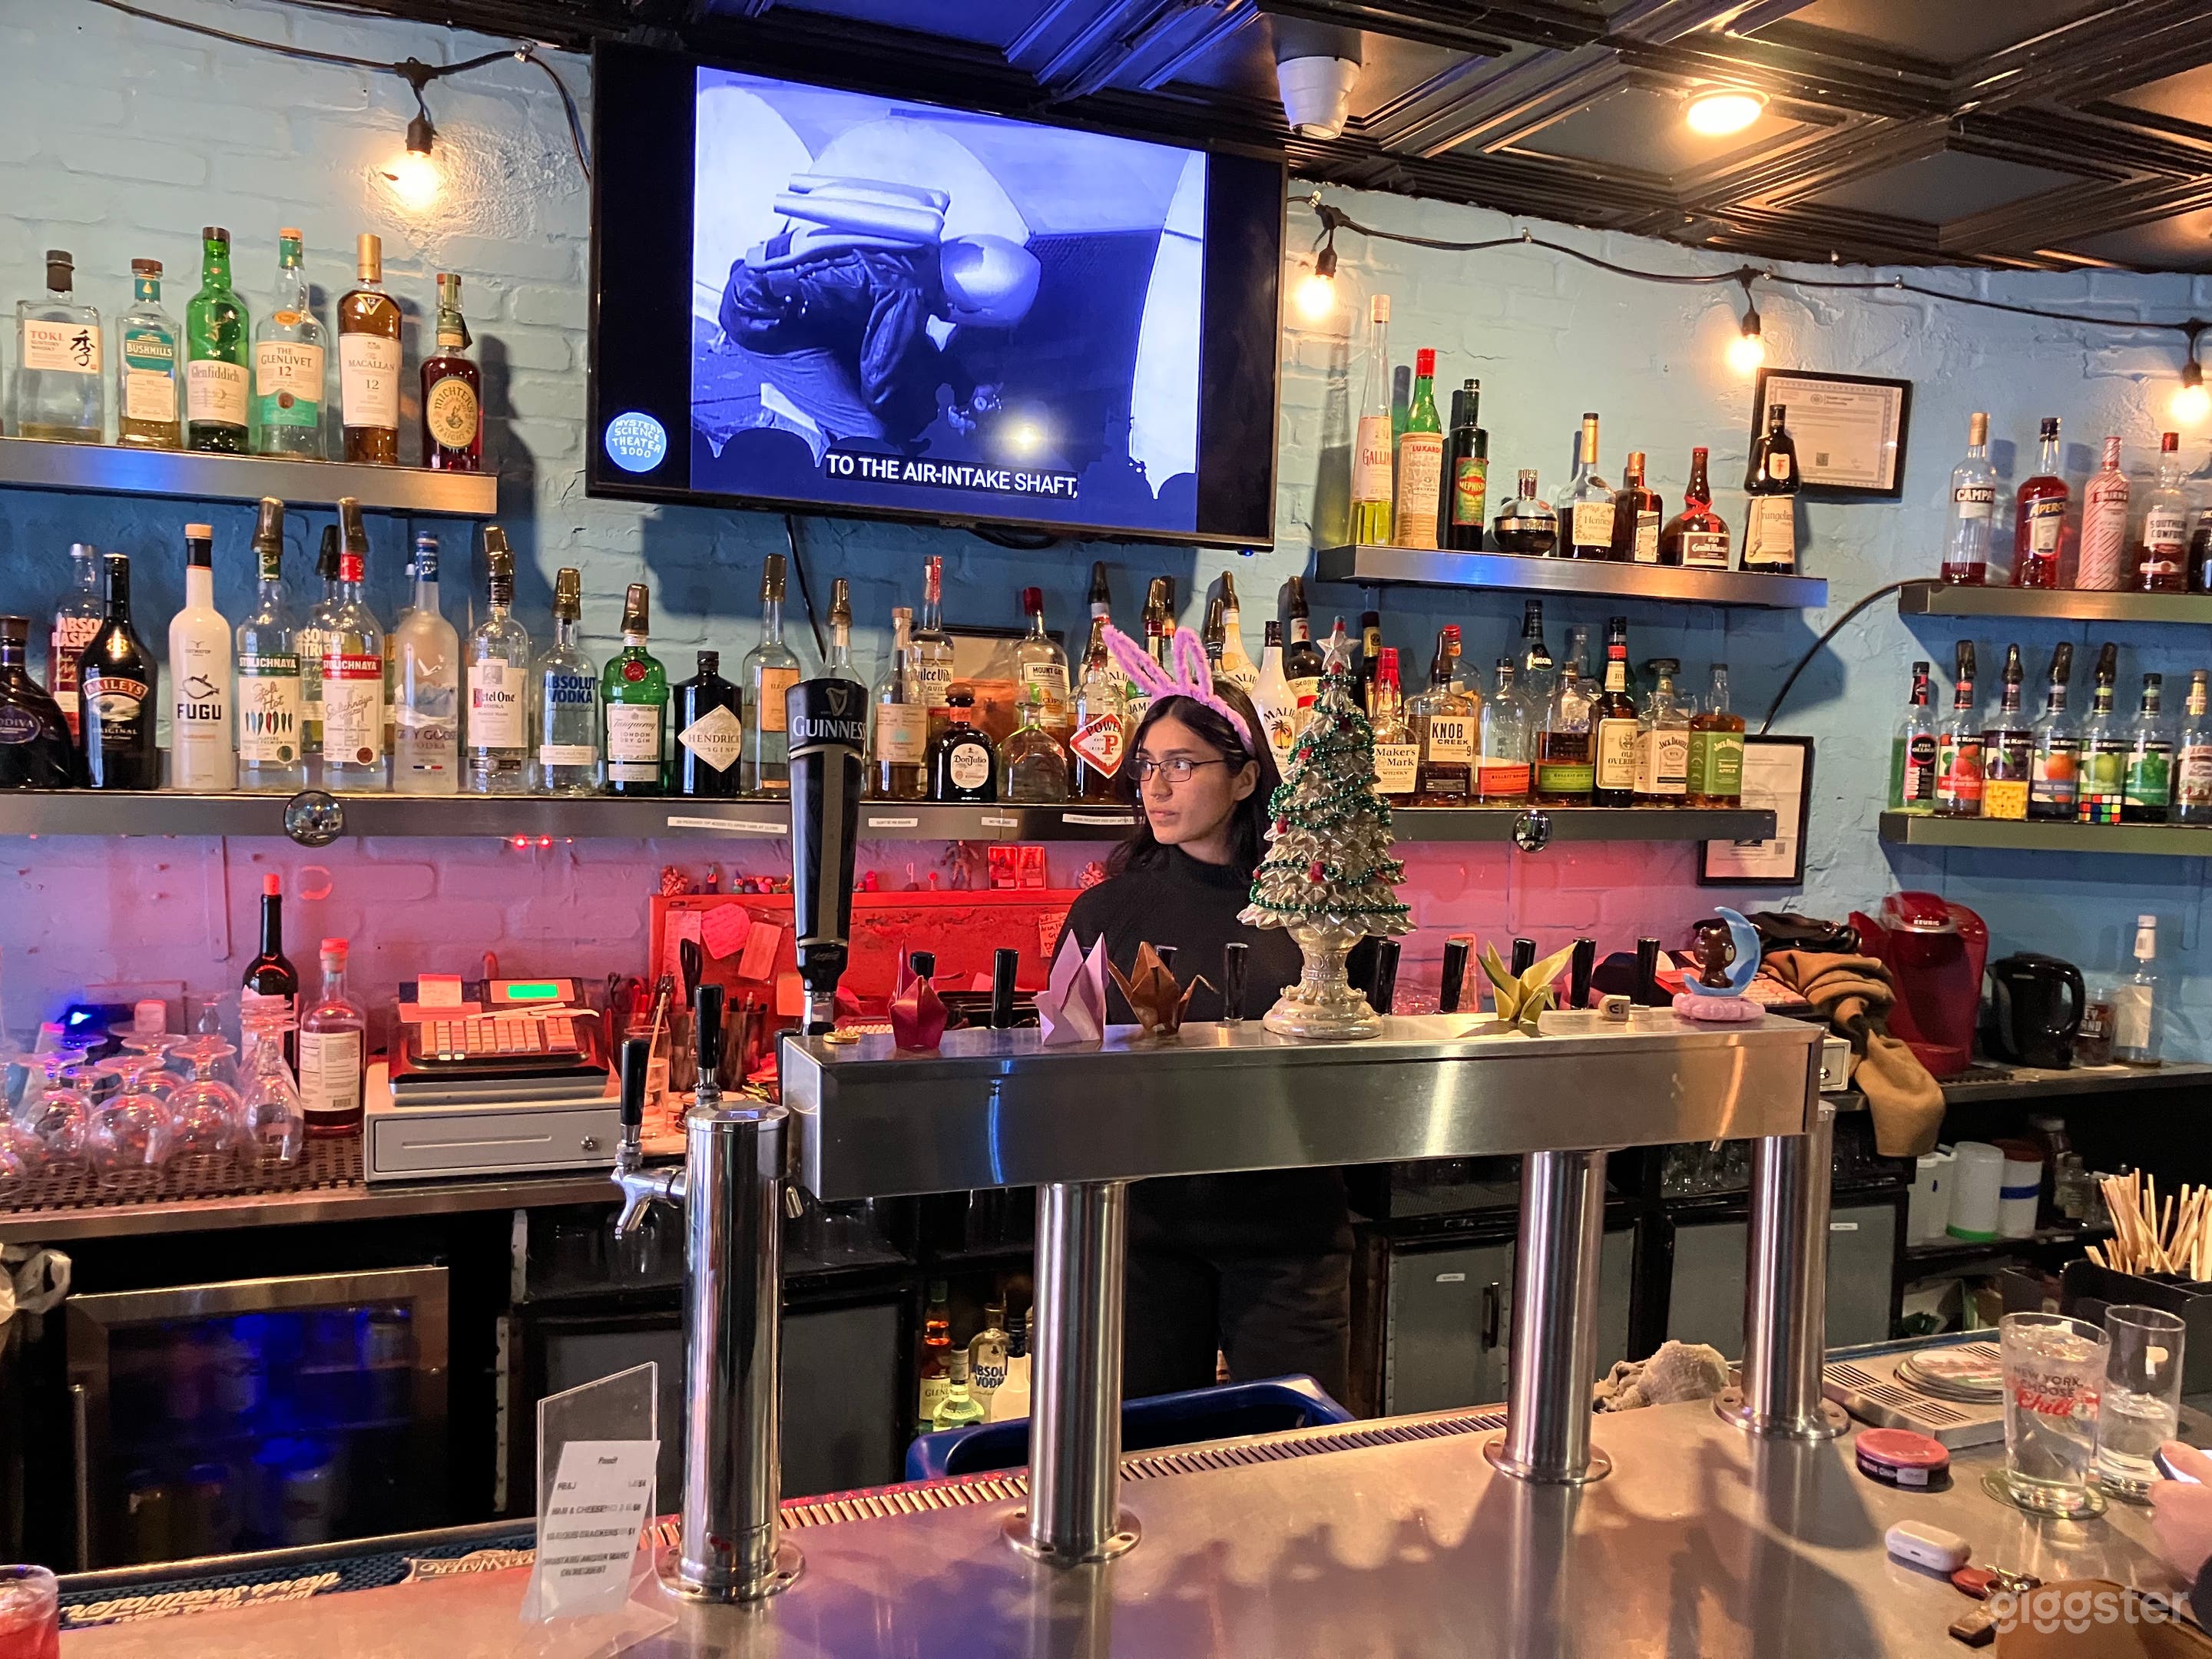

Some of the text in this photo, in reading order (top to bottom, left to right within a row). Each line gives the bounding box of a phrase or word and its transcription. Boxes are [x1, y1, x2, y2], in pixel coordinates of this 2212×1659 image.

[30, 330, 63, 341] TOKI
[70, 329, 96, 367] 季
[126, 343, 173, 356] BUSHMILLS
[261, 355, 312, 368] GLENLIVET
[349, 359, 395, 371] MACALLAN
[278, 366, 293, 376] 12
[366, 379, 379, 390] 12
[615, 419, 662, 434] MYSTERY
[614, 426, 660, 442] SCIENCE
[612, 436, 661, 453] THEATER
[620, 446, 651, 458] 3000
[826, 454, 1078, 498] TO THE AIR-INTAKE SHAFT,
[240, 655, 296, 668] STOLICHNAYA
[323, 660, 377, 671] STOLICHNAYA
[87, 679, 144, 696] BAILEYS
[544, 675, 597, 690] ABSOLUT
[259, 693, 284, 712] Hot
[497, 690, 515, 702] One
[550, 690, 593, 704] VODKA
[177, 704, 221, 720] FUGU
[793, 715, 866, 740] GUINNESS
[1432, 723, 1463, 738] KNOB
[1102, 735, 1118, 755] P
[1466, 746, 1472, 756] 9
[1376, 748, 1416, 757] Maker's
[2014, 1366, 2039, 1379] NEW
[2020, 1379, 2075, 1397] CHOOSE
